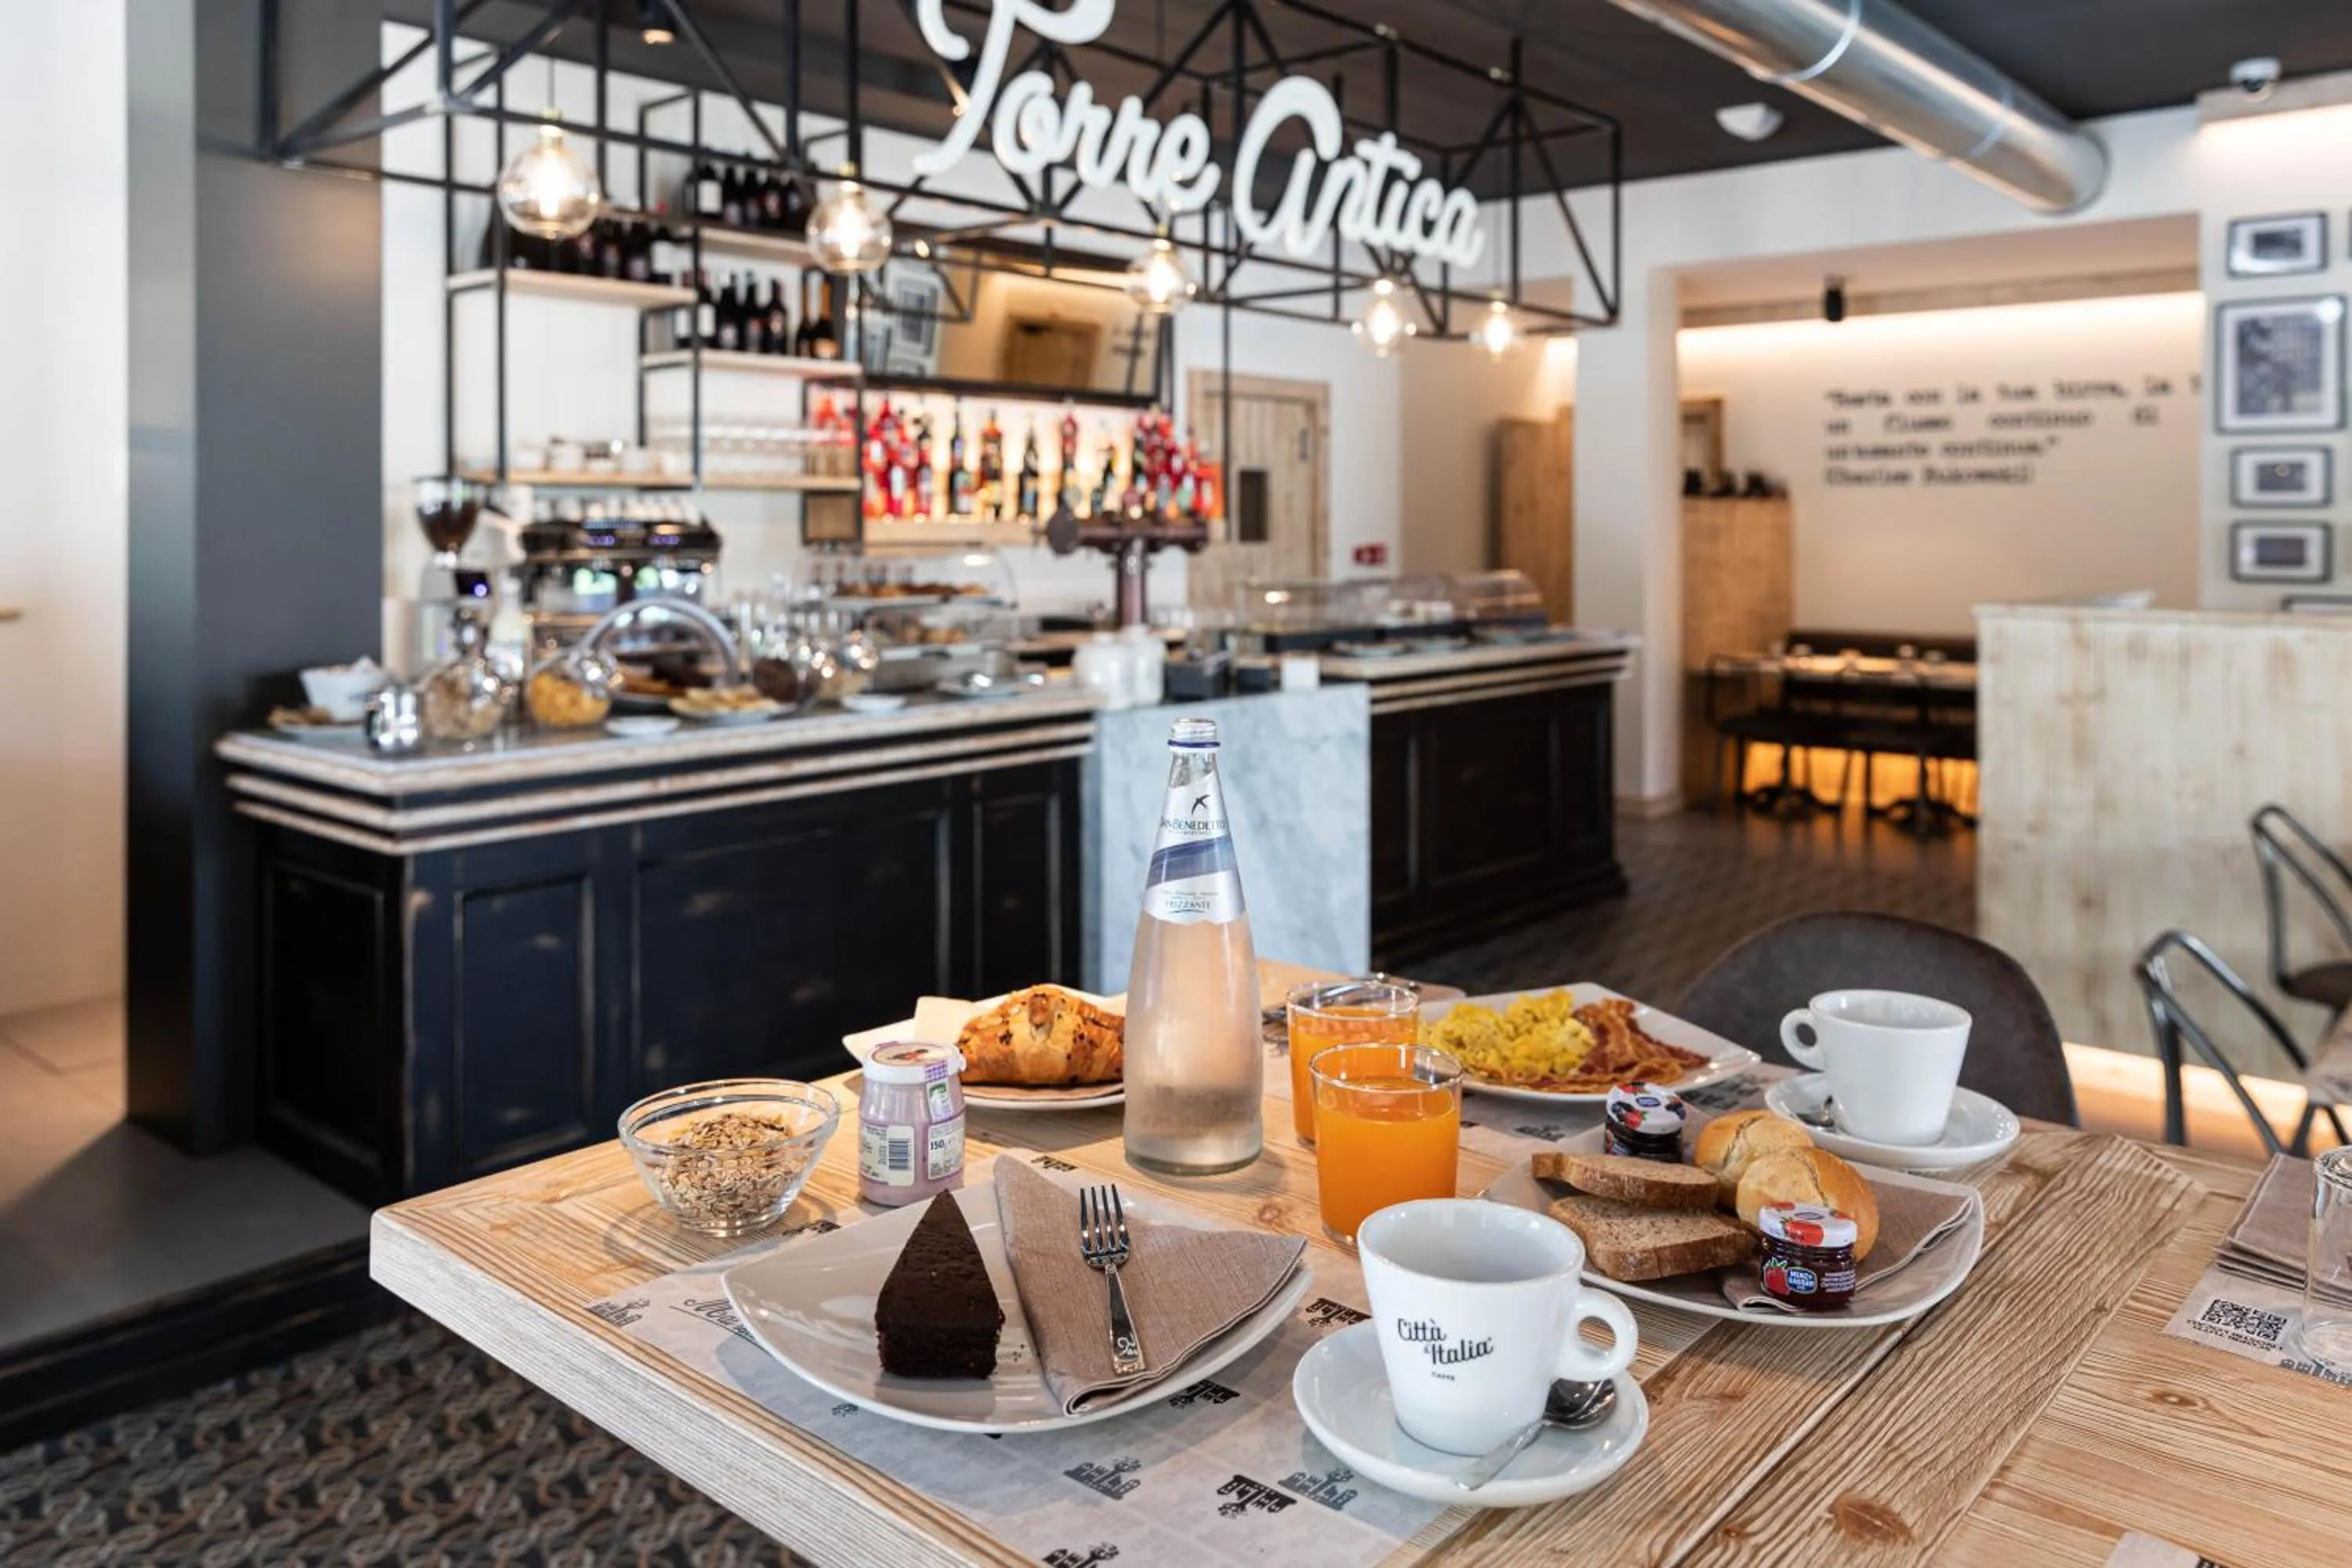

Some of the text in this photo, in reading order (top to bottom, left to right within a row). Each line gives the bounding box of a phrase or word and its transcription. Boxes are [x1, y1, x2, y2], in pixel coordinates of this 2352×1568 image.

[913, 0, 1486, 269] Torre Antica
[1397, 1317, 1447, 1341] Città
